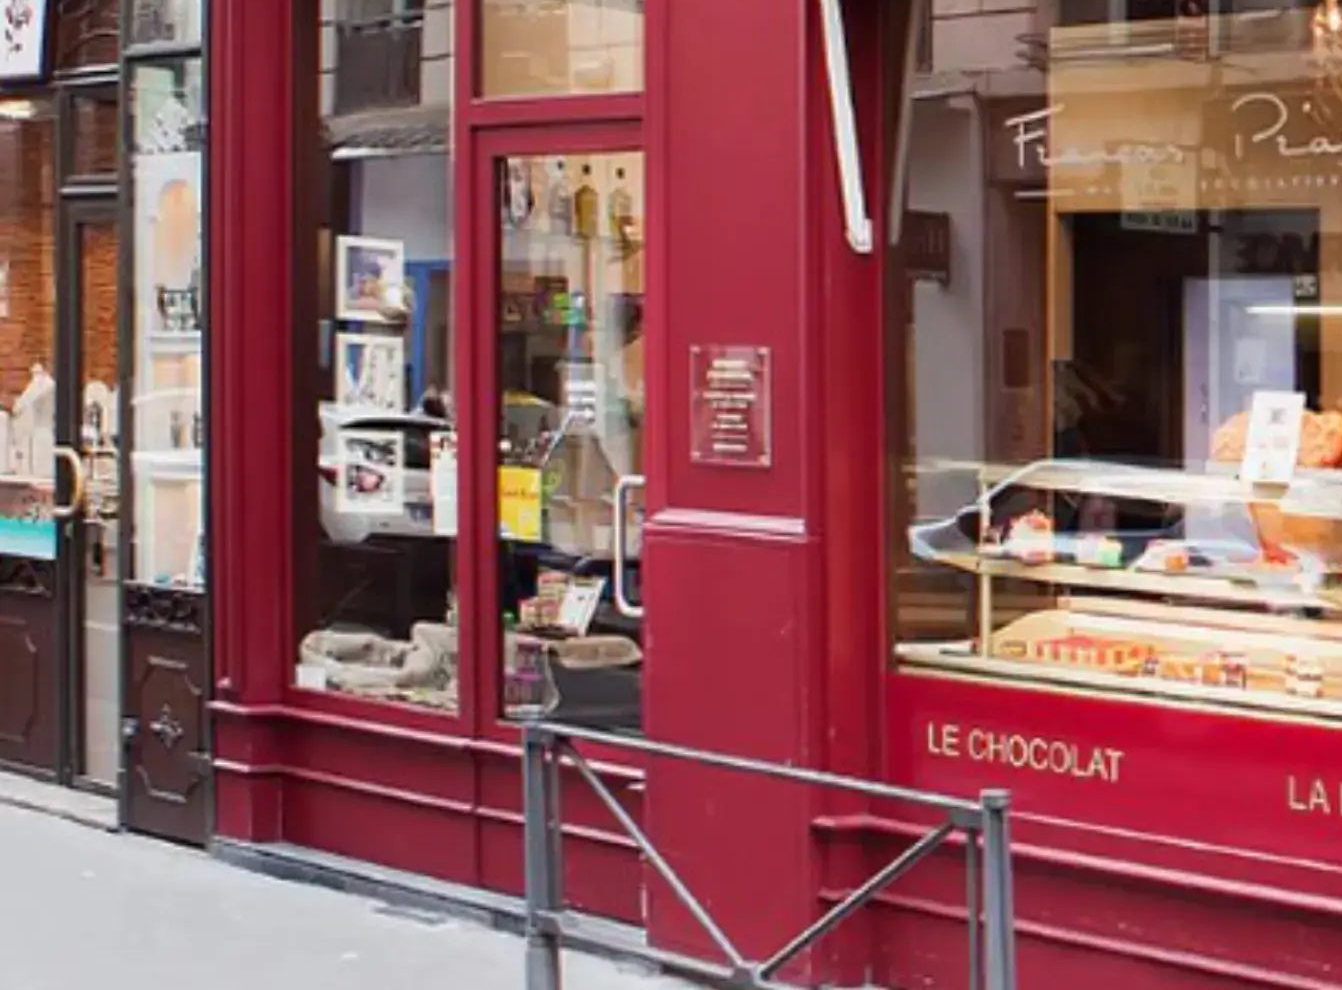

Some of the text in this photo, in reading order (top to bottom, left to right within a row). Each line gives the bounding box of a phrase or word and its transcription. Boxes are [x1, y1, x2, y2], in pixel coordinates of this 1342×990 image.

[927, 721, 1126, 783] LE CHOCOLAT
[1286, 774, 1331, 815] LA
